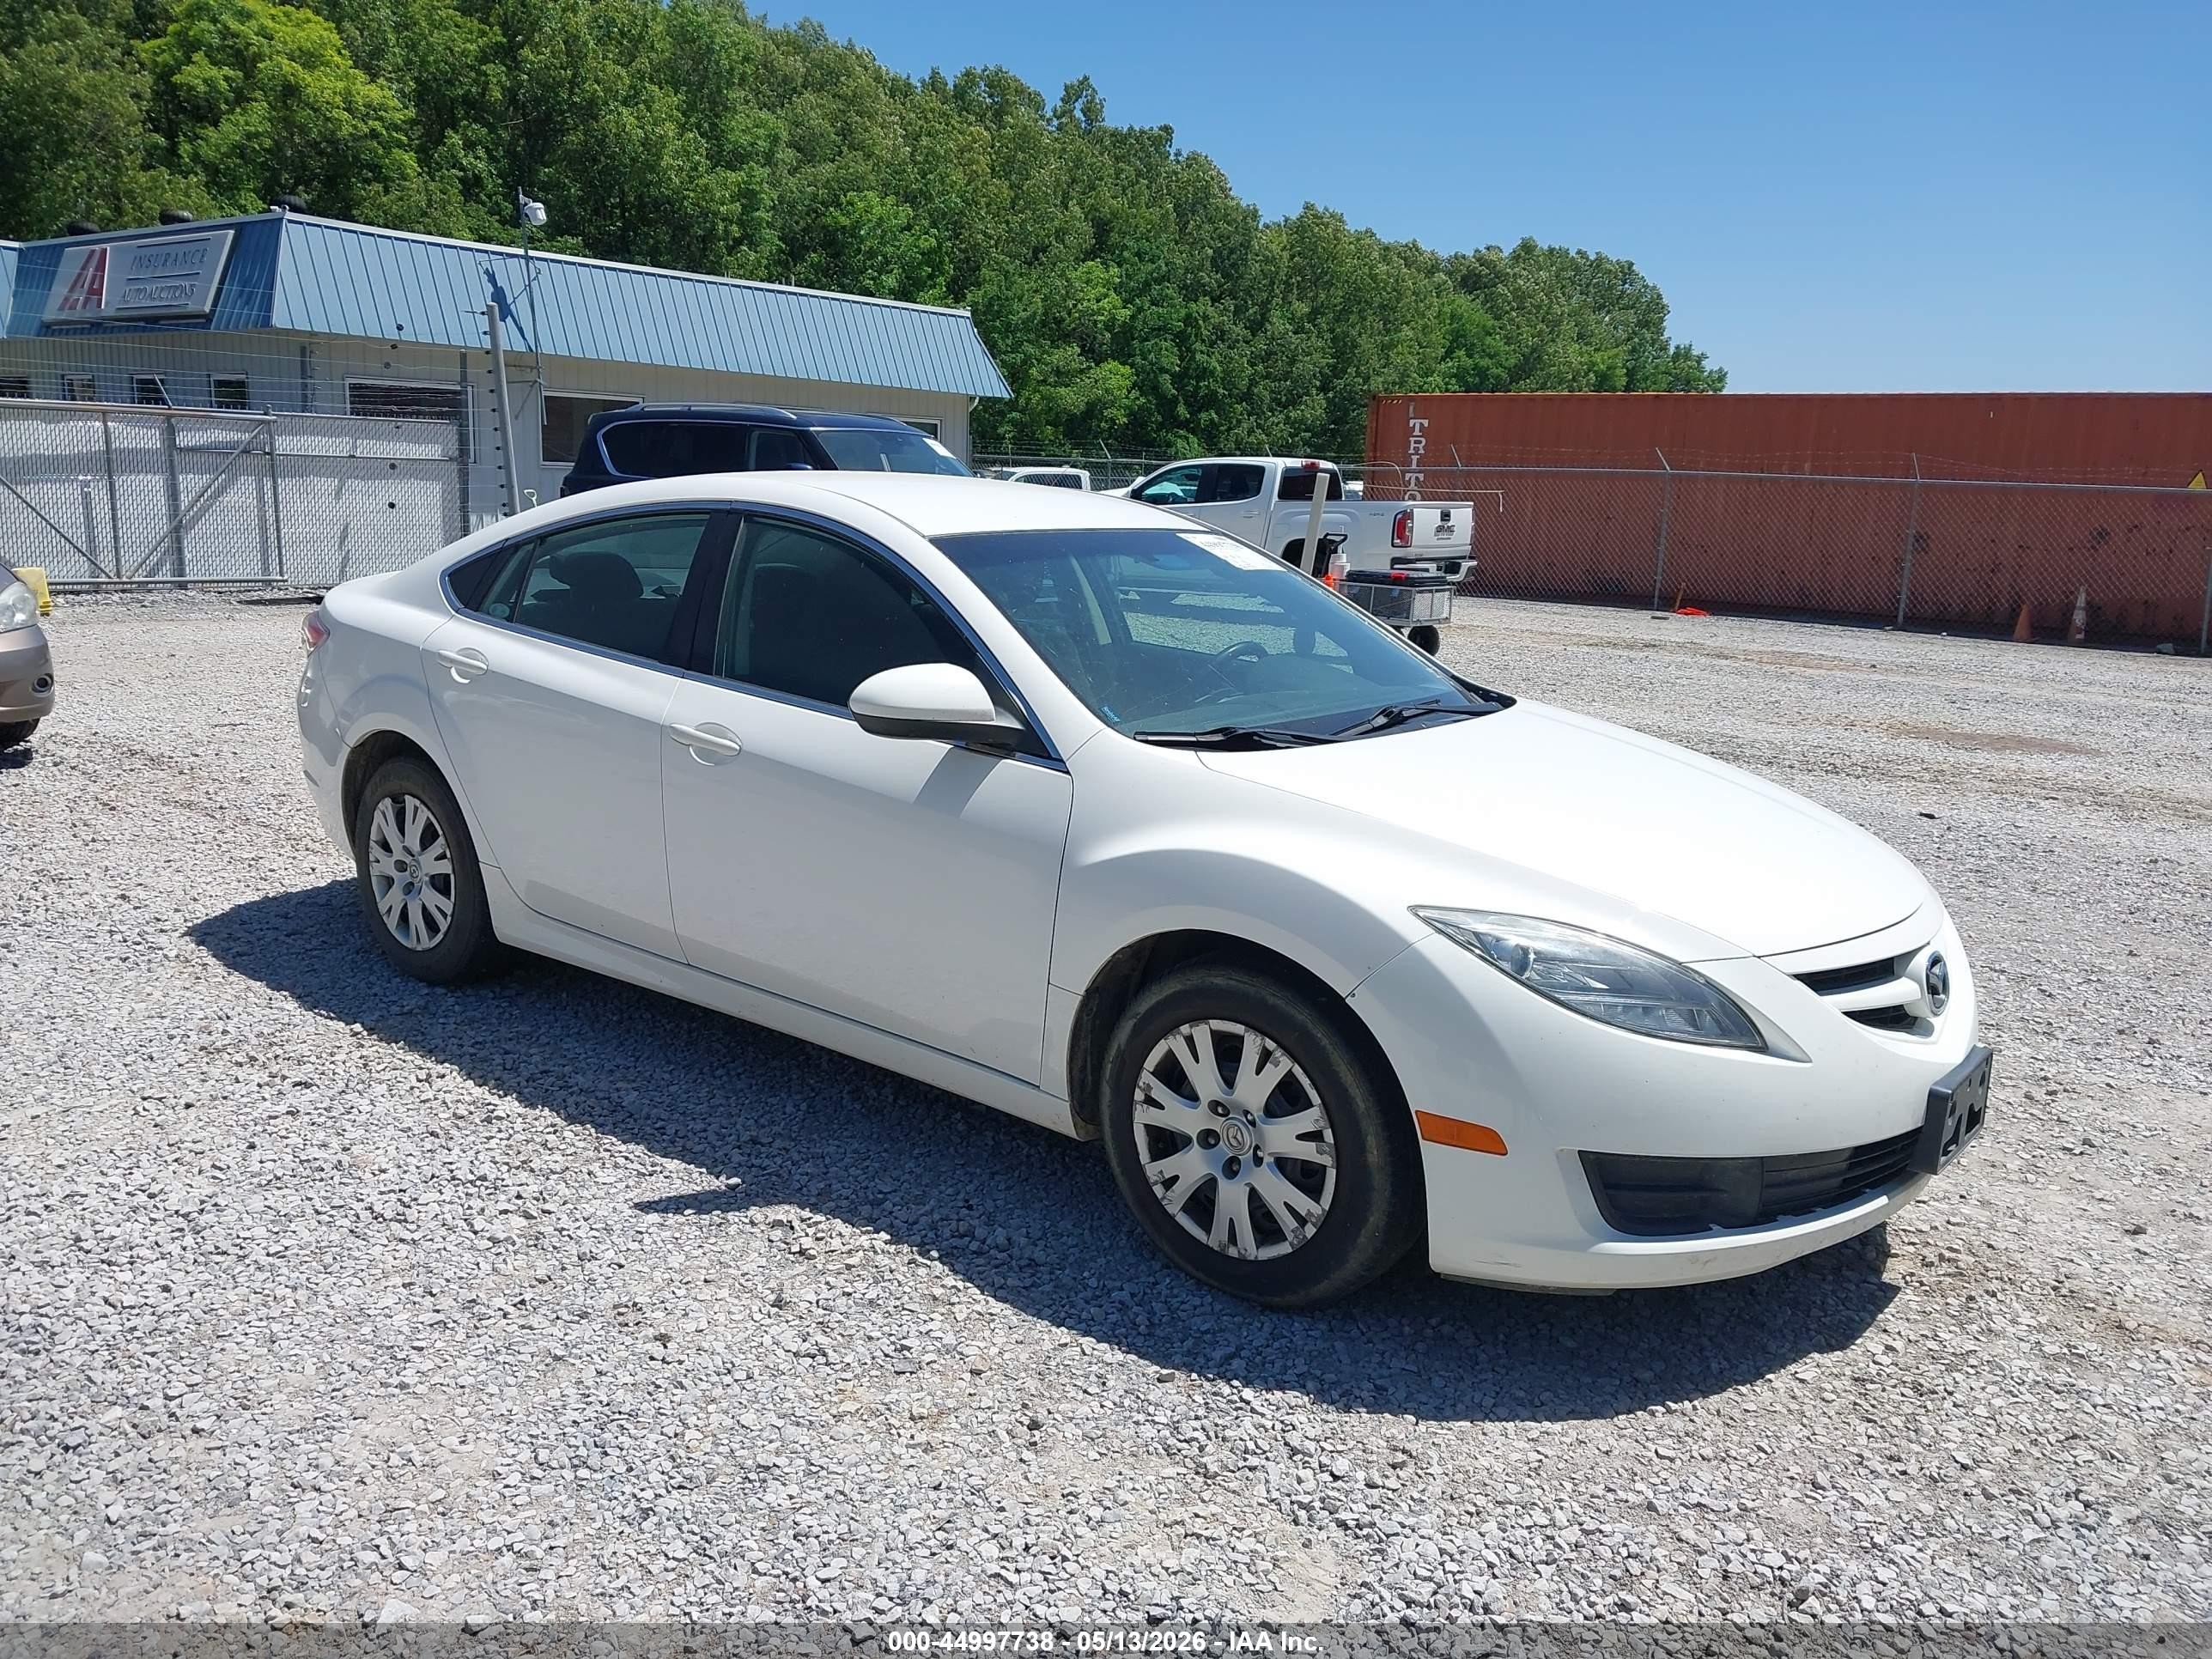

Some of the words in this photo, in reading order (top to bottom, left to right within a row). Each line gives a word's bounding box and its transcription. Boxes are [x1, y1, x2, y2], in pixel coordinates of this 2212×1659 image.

[131, 248, 208, 270] INSURANCE
[121, 286, 148, 301] AUTO
[149, 282, 197, 301] AUCTIONS
[1436, 525, 1455, 533] GMC
